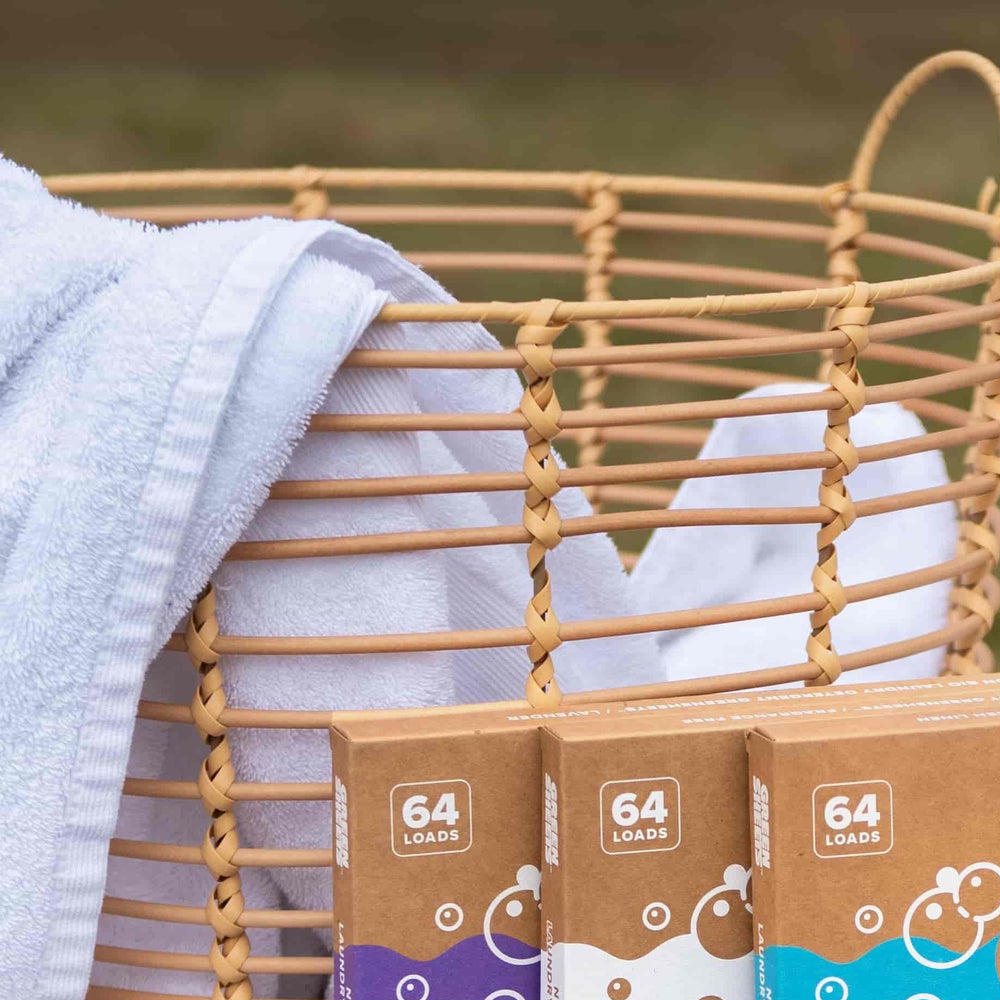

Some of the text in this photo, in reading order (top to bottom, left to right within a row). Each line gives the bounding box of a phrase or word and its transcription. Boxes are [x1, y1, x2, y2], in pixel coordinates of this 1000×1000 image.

[756, 689, 857, 703] DETERGENT
[863, 682, 944, 694] LAUNDRY
[507, 709, 600, 722] LAVENDER
[402, 792, 460, 829] 64
[611, 790, 669, 827] 64
[824, 793, 881, 830] 64
[403, 829, 460, 845] LOADS
[612, 827, 668, 843] LOADS
[825, 830, 881, 846] LOADS
